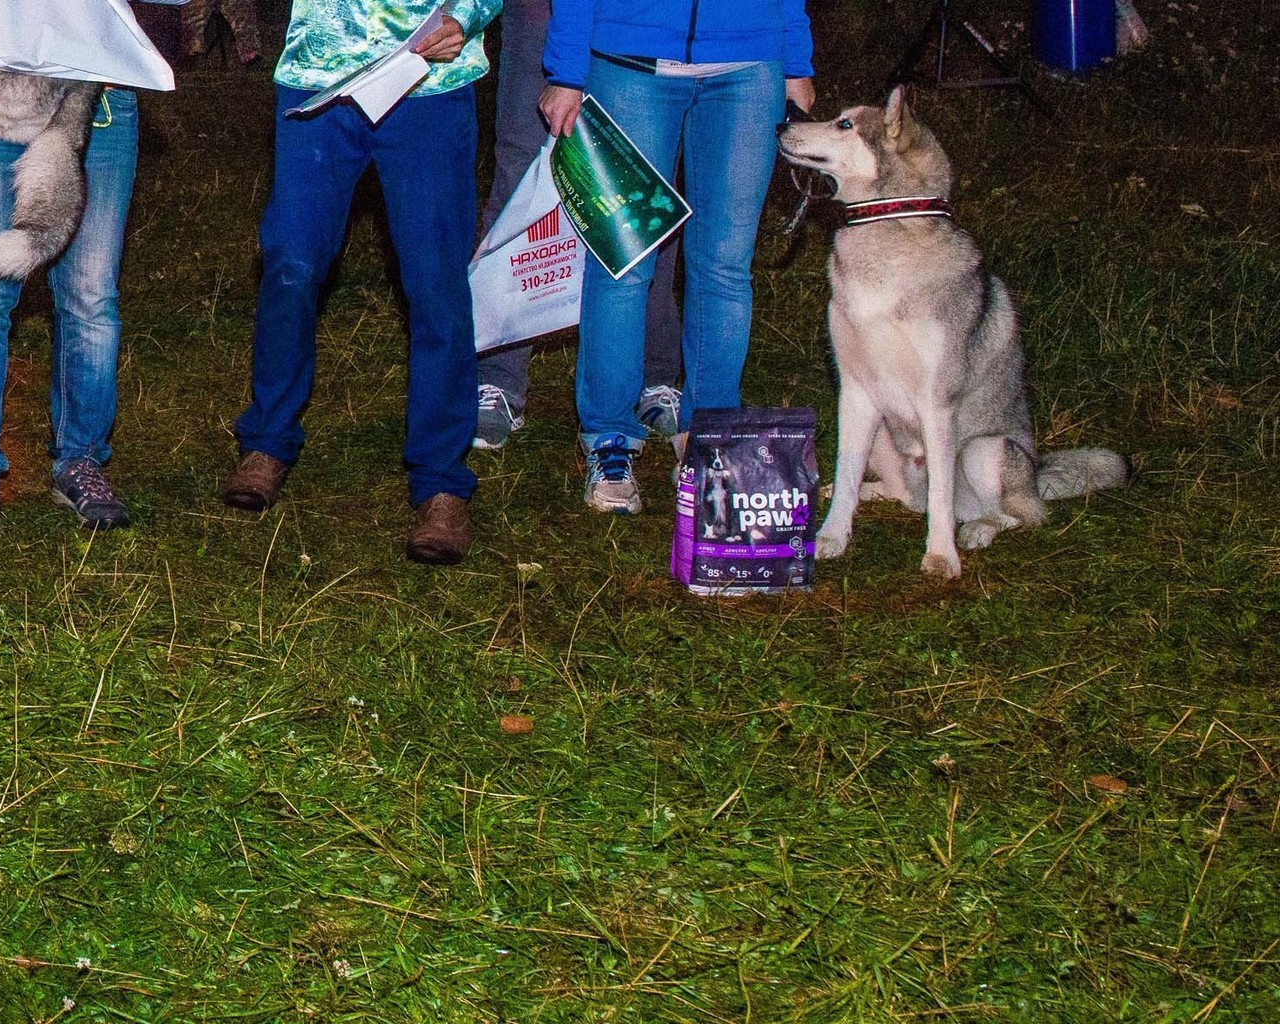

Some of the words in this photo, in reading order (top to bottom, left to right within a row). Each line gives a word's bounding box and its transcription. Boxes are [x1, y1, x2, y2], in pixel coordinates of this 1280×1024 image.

[510, 238, 577, 266] НАХОДКА
[521, 265, 572, 292] 310-22-22
[732, 487, 809, 509] north
[739, 510, 793, 531] paw
